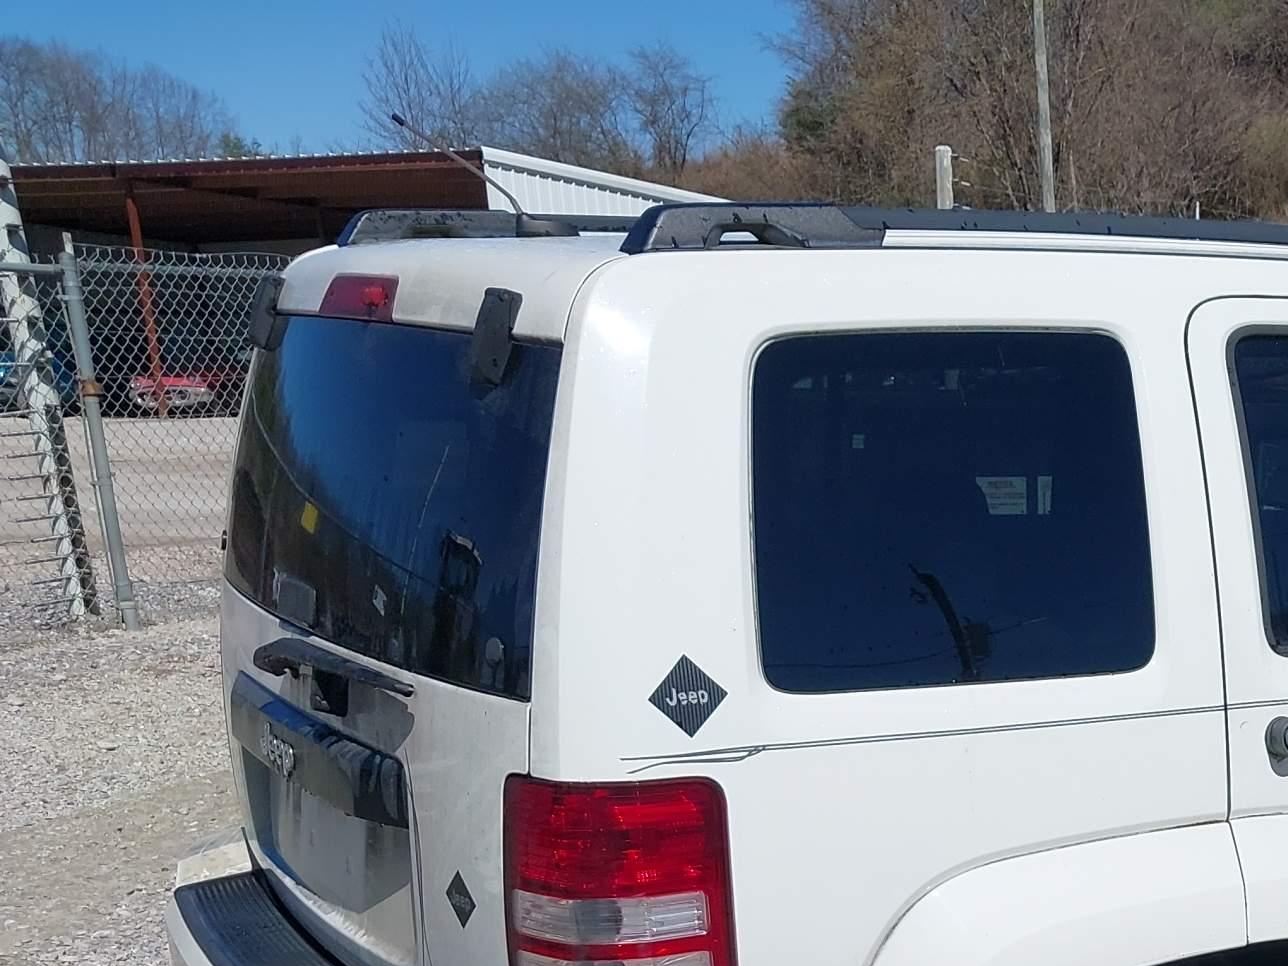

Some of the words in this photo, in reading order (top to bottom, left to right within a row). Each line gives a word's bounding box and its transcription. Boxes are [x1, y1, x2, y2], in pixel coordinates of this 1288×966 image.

[665, 687, 709, 706] Jeep
[260, 720, 295, 777] Jeep
[451, 888, 471, 912] Jeep
